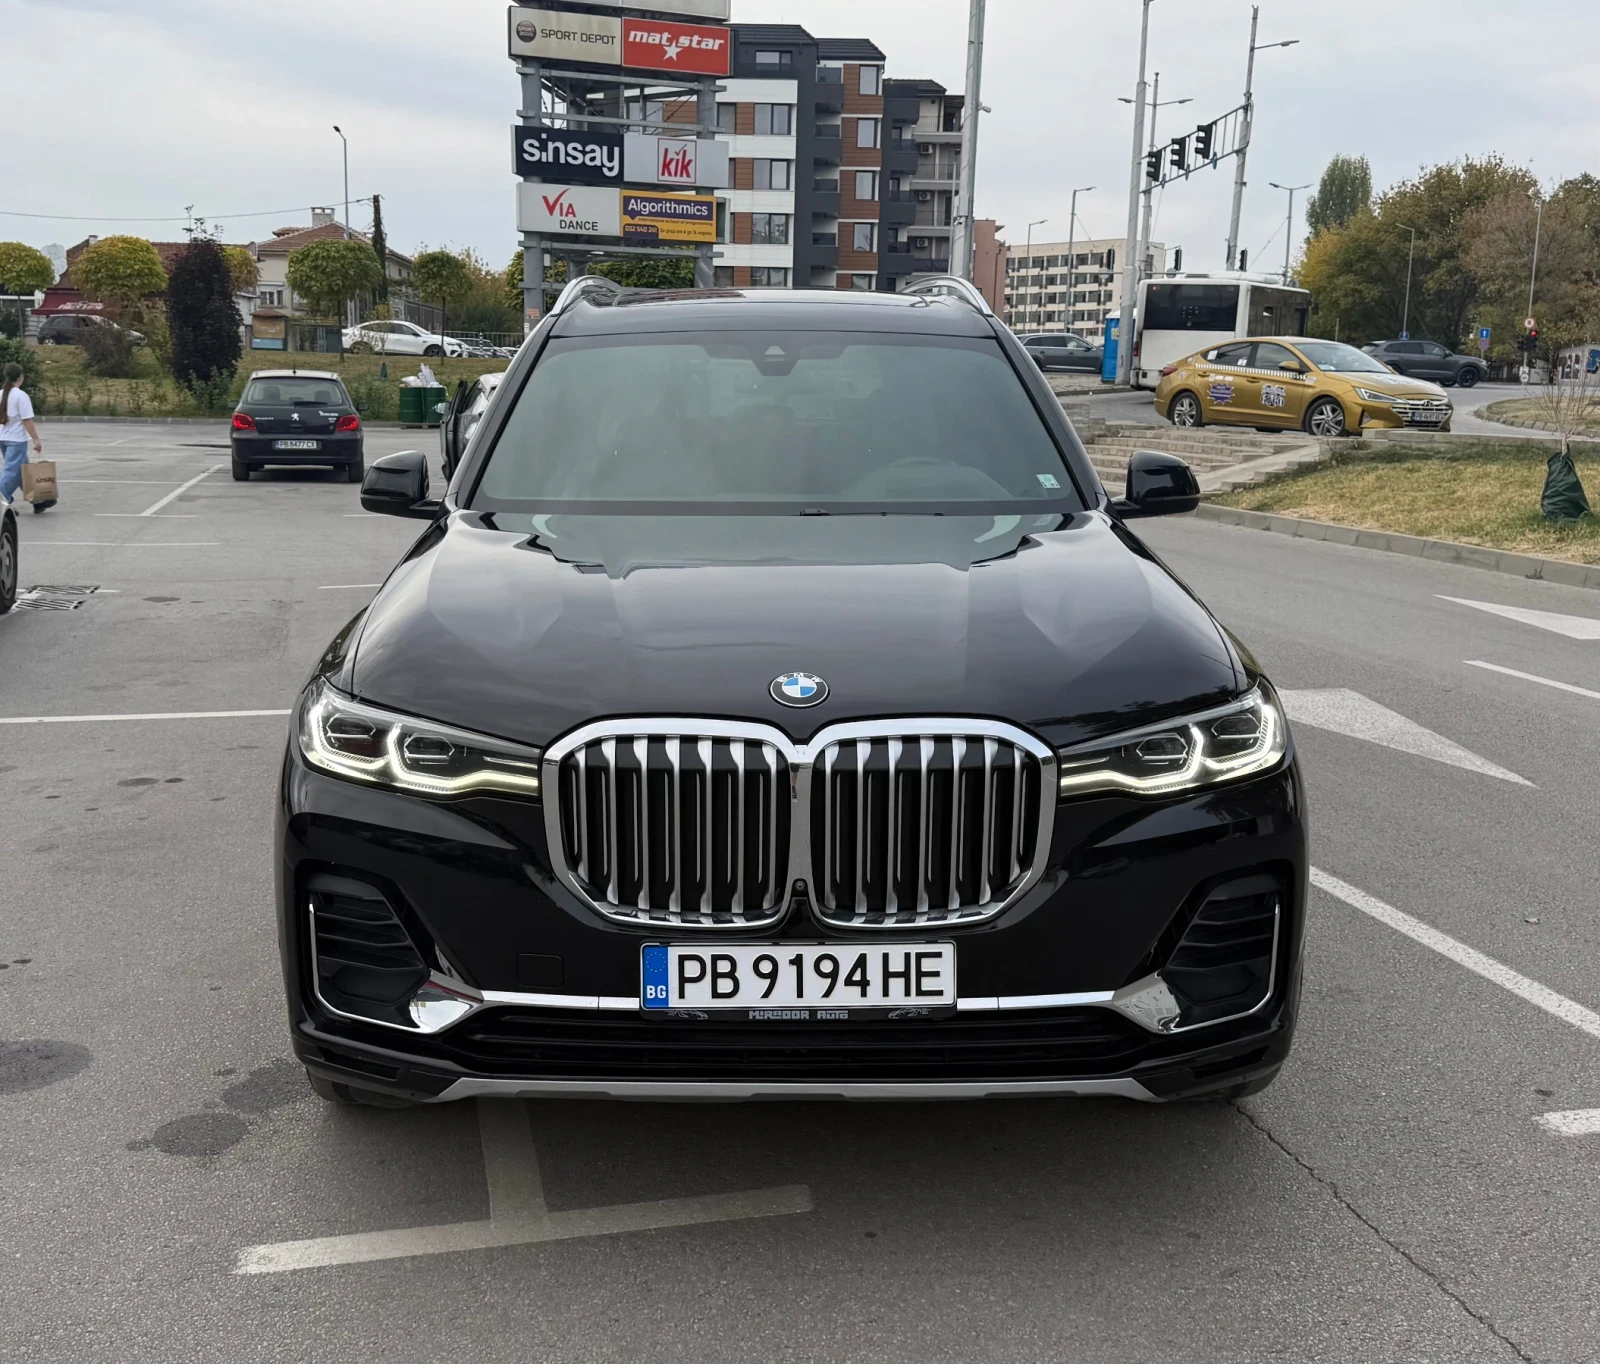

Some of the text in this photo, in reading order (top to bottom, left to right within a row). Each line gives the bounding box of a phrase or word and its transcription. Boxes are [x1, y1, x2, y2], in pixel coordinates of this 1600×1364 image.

[541, 28, 617, 46] SPORT DEPOT
[628, 30, 725, 50] mat star
[522, 133, 620, 177] sinsay
[628, 198, 709, 216] Algorithmics
[559, 219, 599, 232] DANCE
[776, 672, 822, 683] BMW
[677, 951, 944, 999] PB 9194 HE
[646, 985, 667, 999] BG
